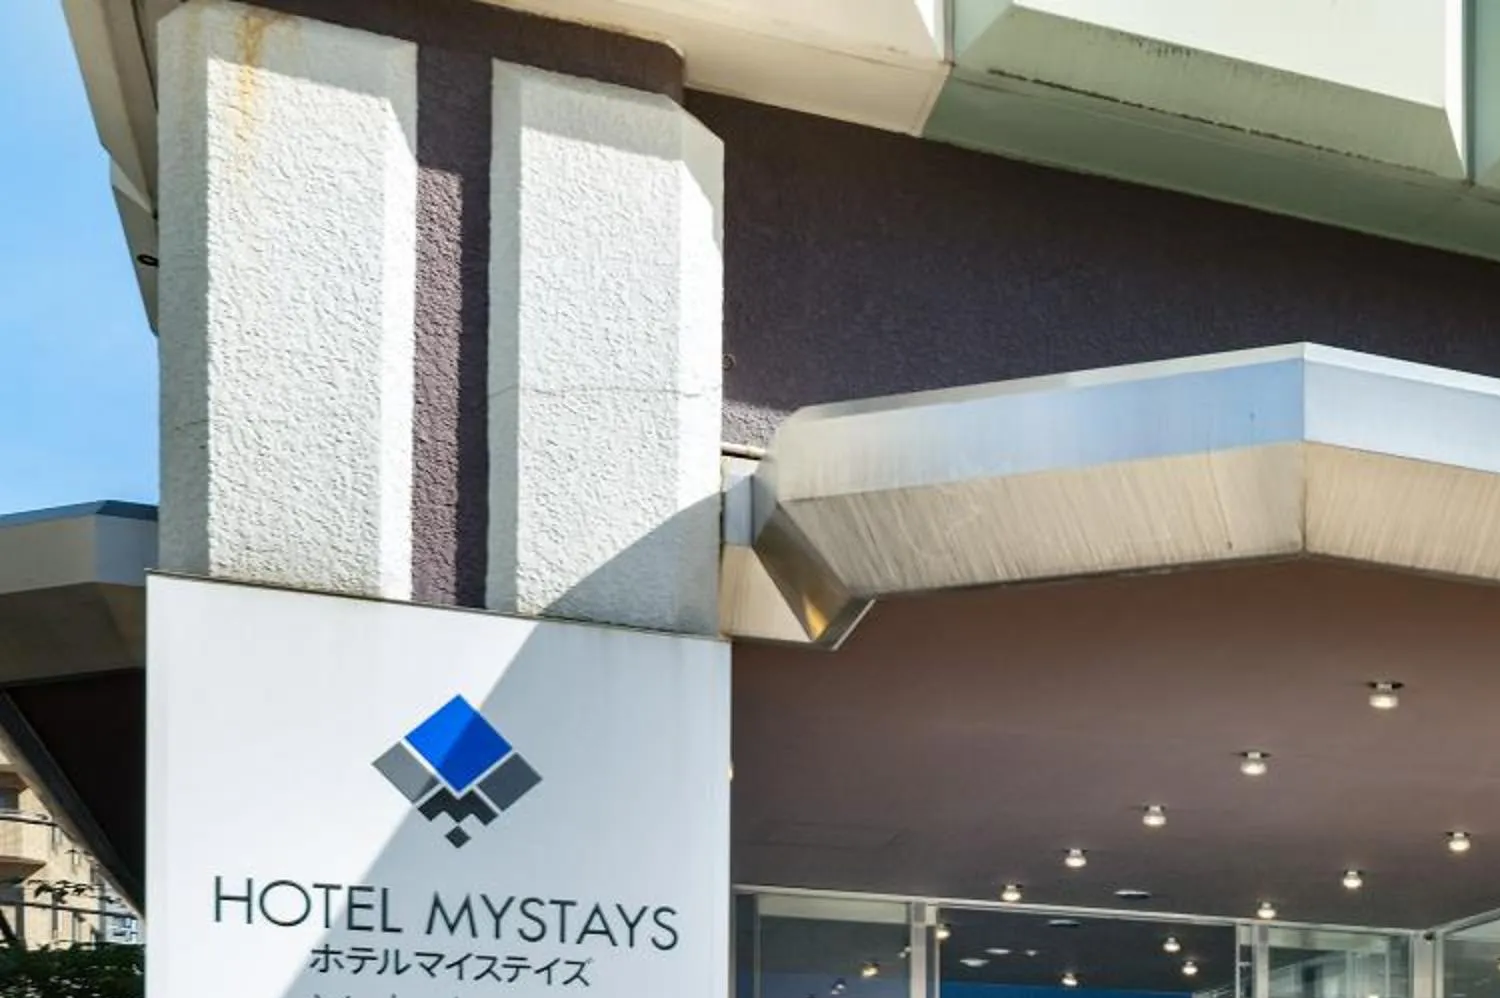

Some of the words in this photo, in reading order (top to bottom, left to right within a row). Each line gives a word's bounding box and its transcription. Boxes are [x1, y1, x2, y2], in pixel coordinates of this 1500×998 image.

[213, 876, 404, 933] HOTEL
[425, 891, 680, 952] MYSTAYS
[309, 943, 594, 987] ホテルマイステイズ
